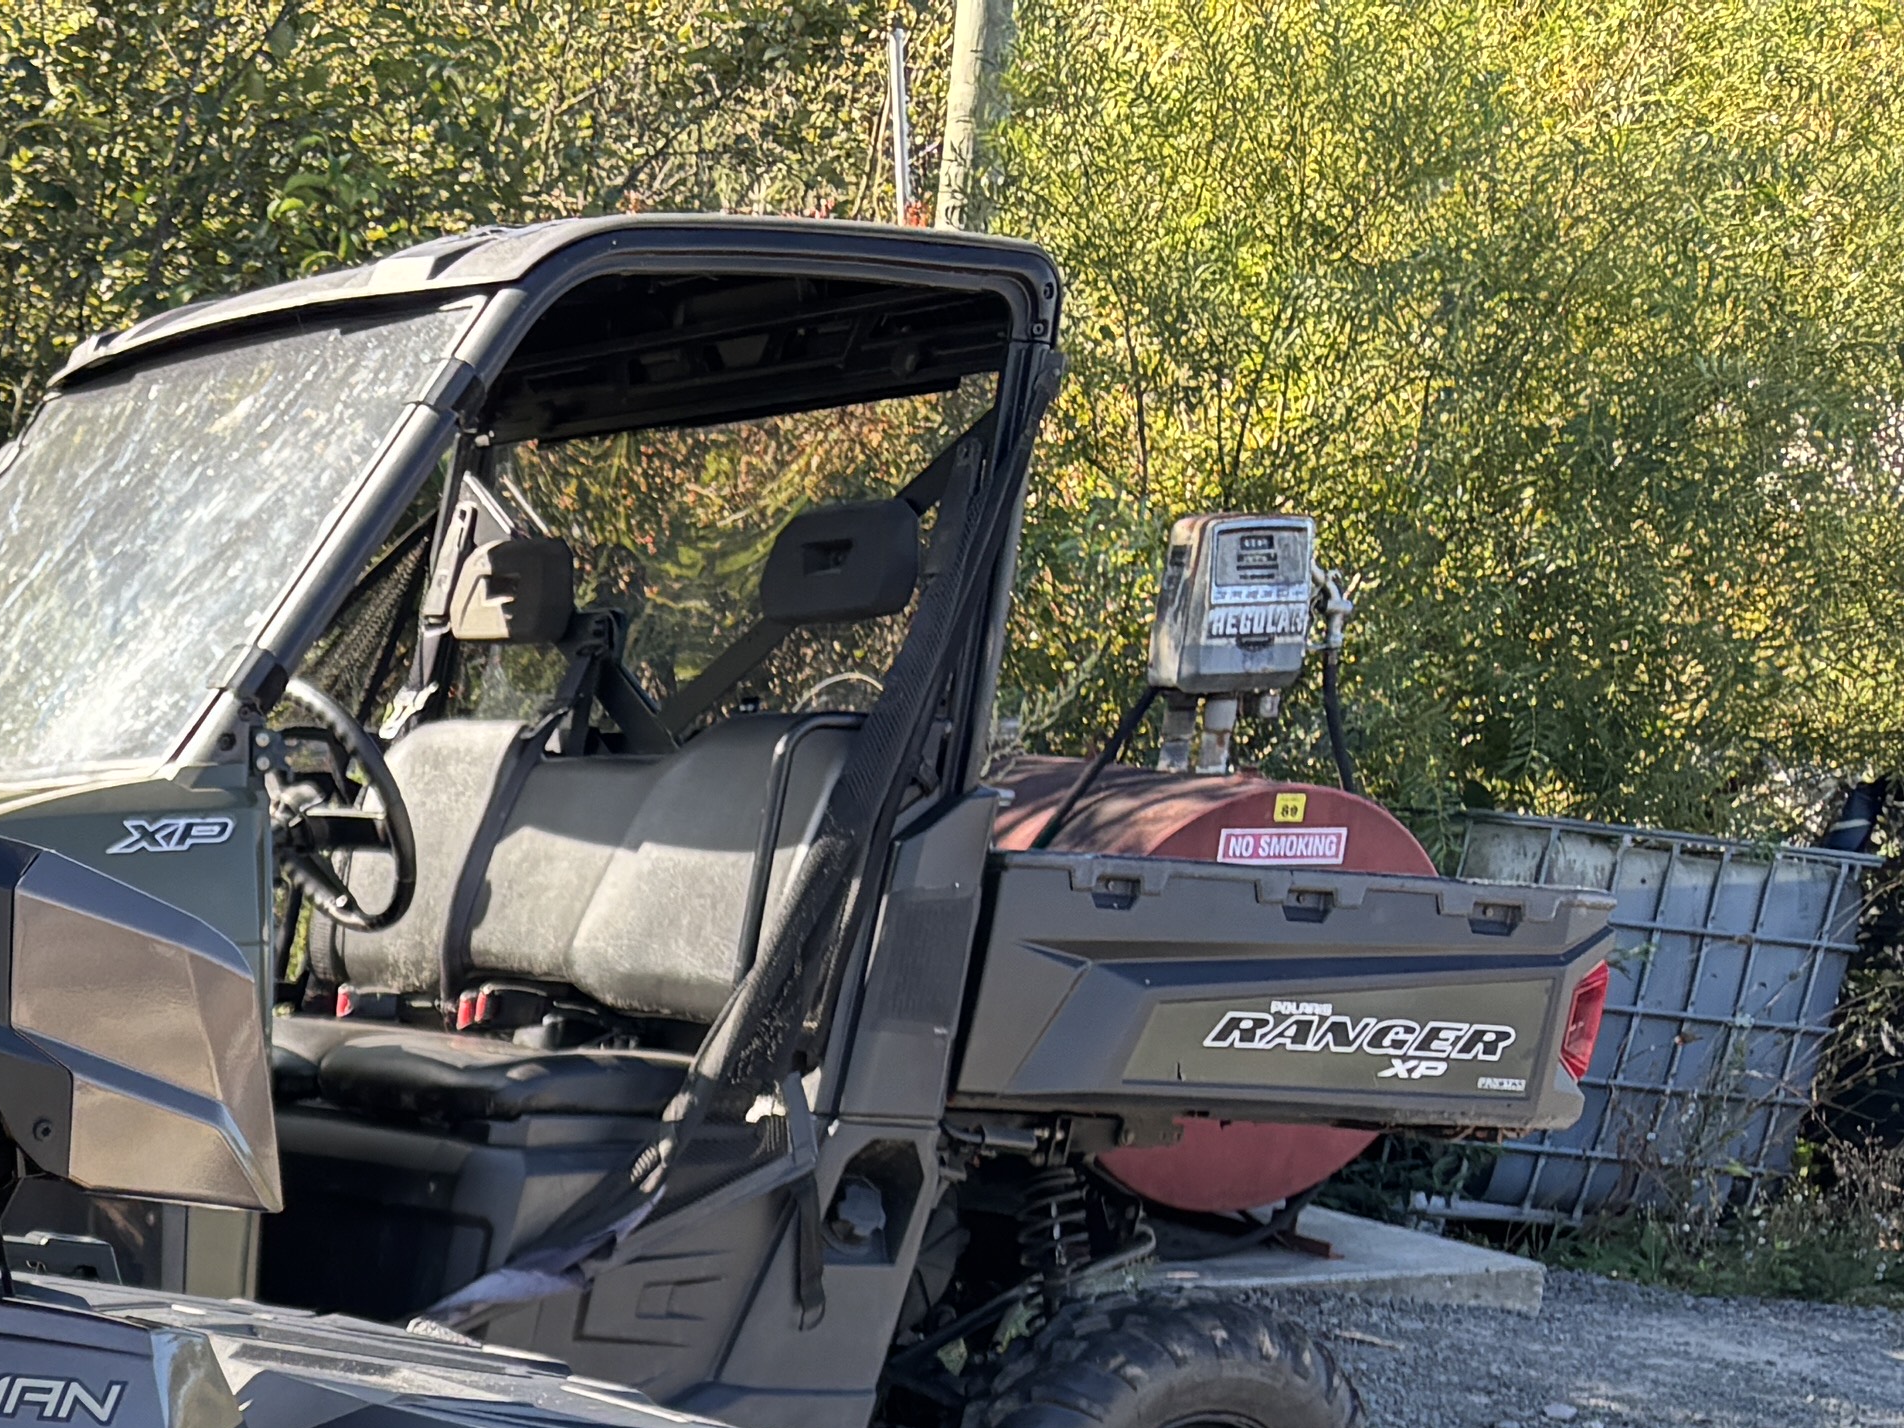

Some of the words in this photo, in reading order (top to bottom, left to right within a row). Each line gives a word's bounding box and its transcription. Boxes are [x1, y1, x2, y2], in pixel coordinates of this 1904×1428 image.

[106, 817, 235, 854] XP
[1229, 835, 1254, 857] NO
[1258, 834, 1337, 857] SMOKING
[1270, 1000, 1333, 1016] POLARIS
[1203, 1011, 1516, 1062] RANGER
[1377, 1059, 1448, 1079] XP
